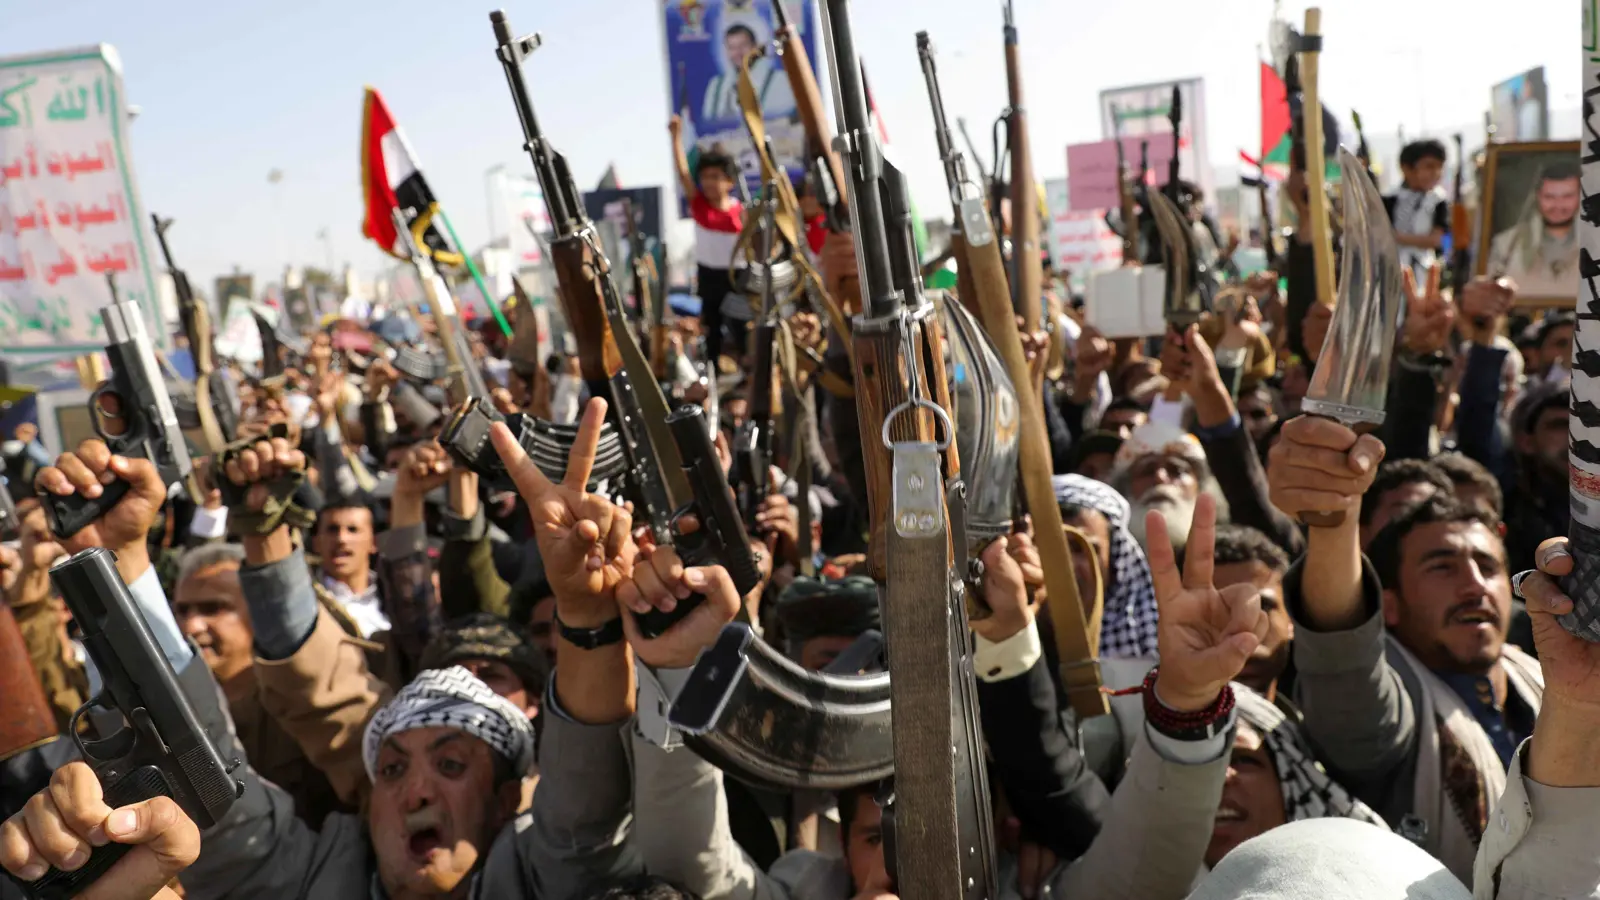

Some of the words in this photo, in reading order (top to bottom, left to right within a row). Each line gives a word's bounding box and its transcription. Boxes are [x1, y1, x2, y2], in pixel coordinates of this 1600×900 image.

[0, 73, 38, 128] أك
[47, 74, 106, 122] الله
[48, 139, 116, 183] الموت
